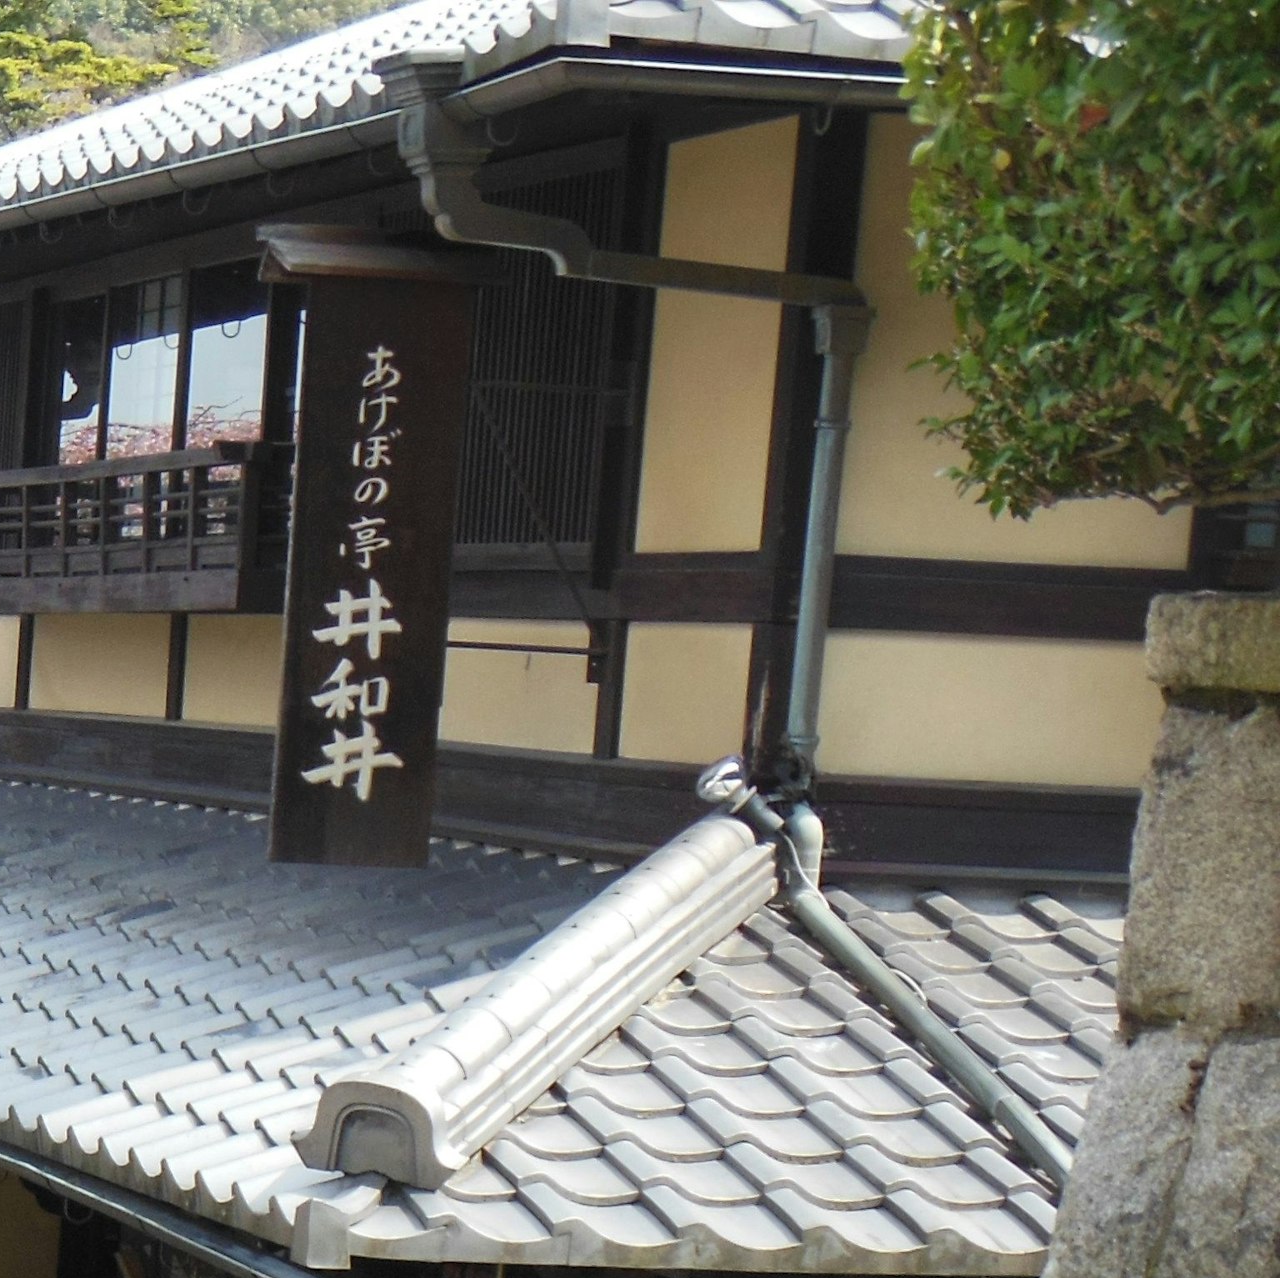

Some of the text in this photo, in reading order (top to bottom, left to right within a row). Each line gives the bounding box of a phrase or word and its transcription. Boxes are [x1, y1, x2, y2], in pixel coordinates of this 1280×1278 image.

[301, 345, 403, 800] あけぼの亭 井和井
